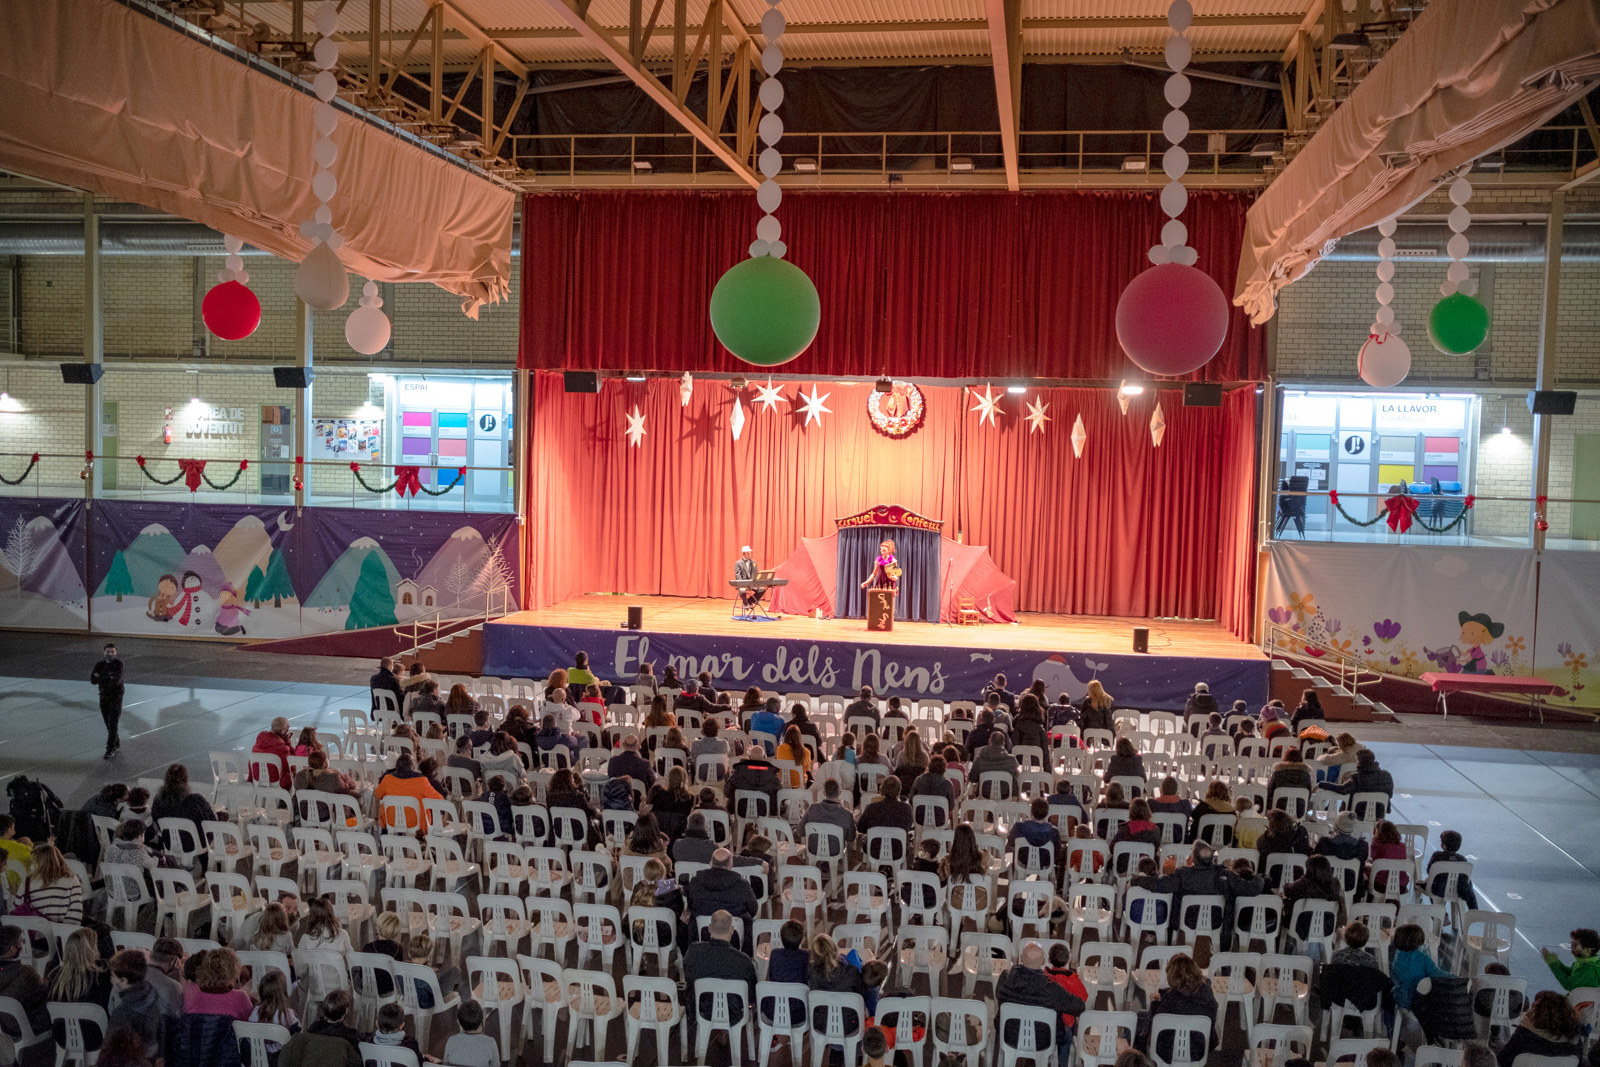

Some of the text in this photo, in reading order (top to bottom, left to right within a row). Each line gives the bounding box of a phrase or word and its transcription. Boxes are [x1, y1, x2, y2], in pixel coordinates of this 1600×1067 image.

[404, 383, 428, 391] ESPAI
[229, 407, 245, 420] DE
[1382, 404, 1437, 413] LA LLAVOR
[187, 422, 244, 435] JOVENTUT
[615, 635, 950, 696] El mar dels Nens
